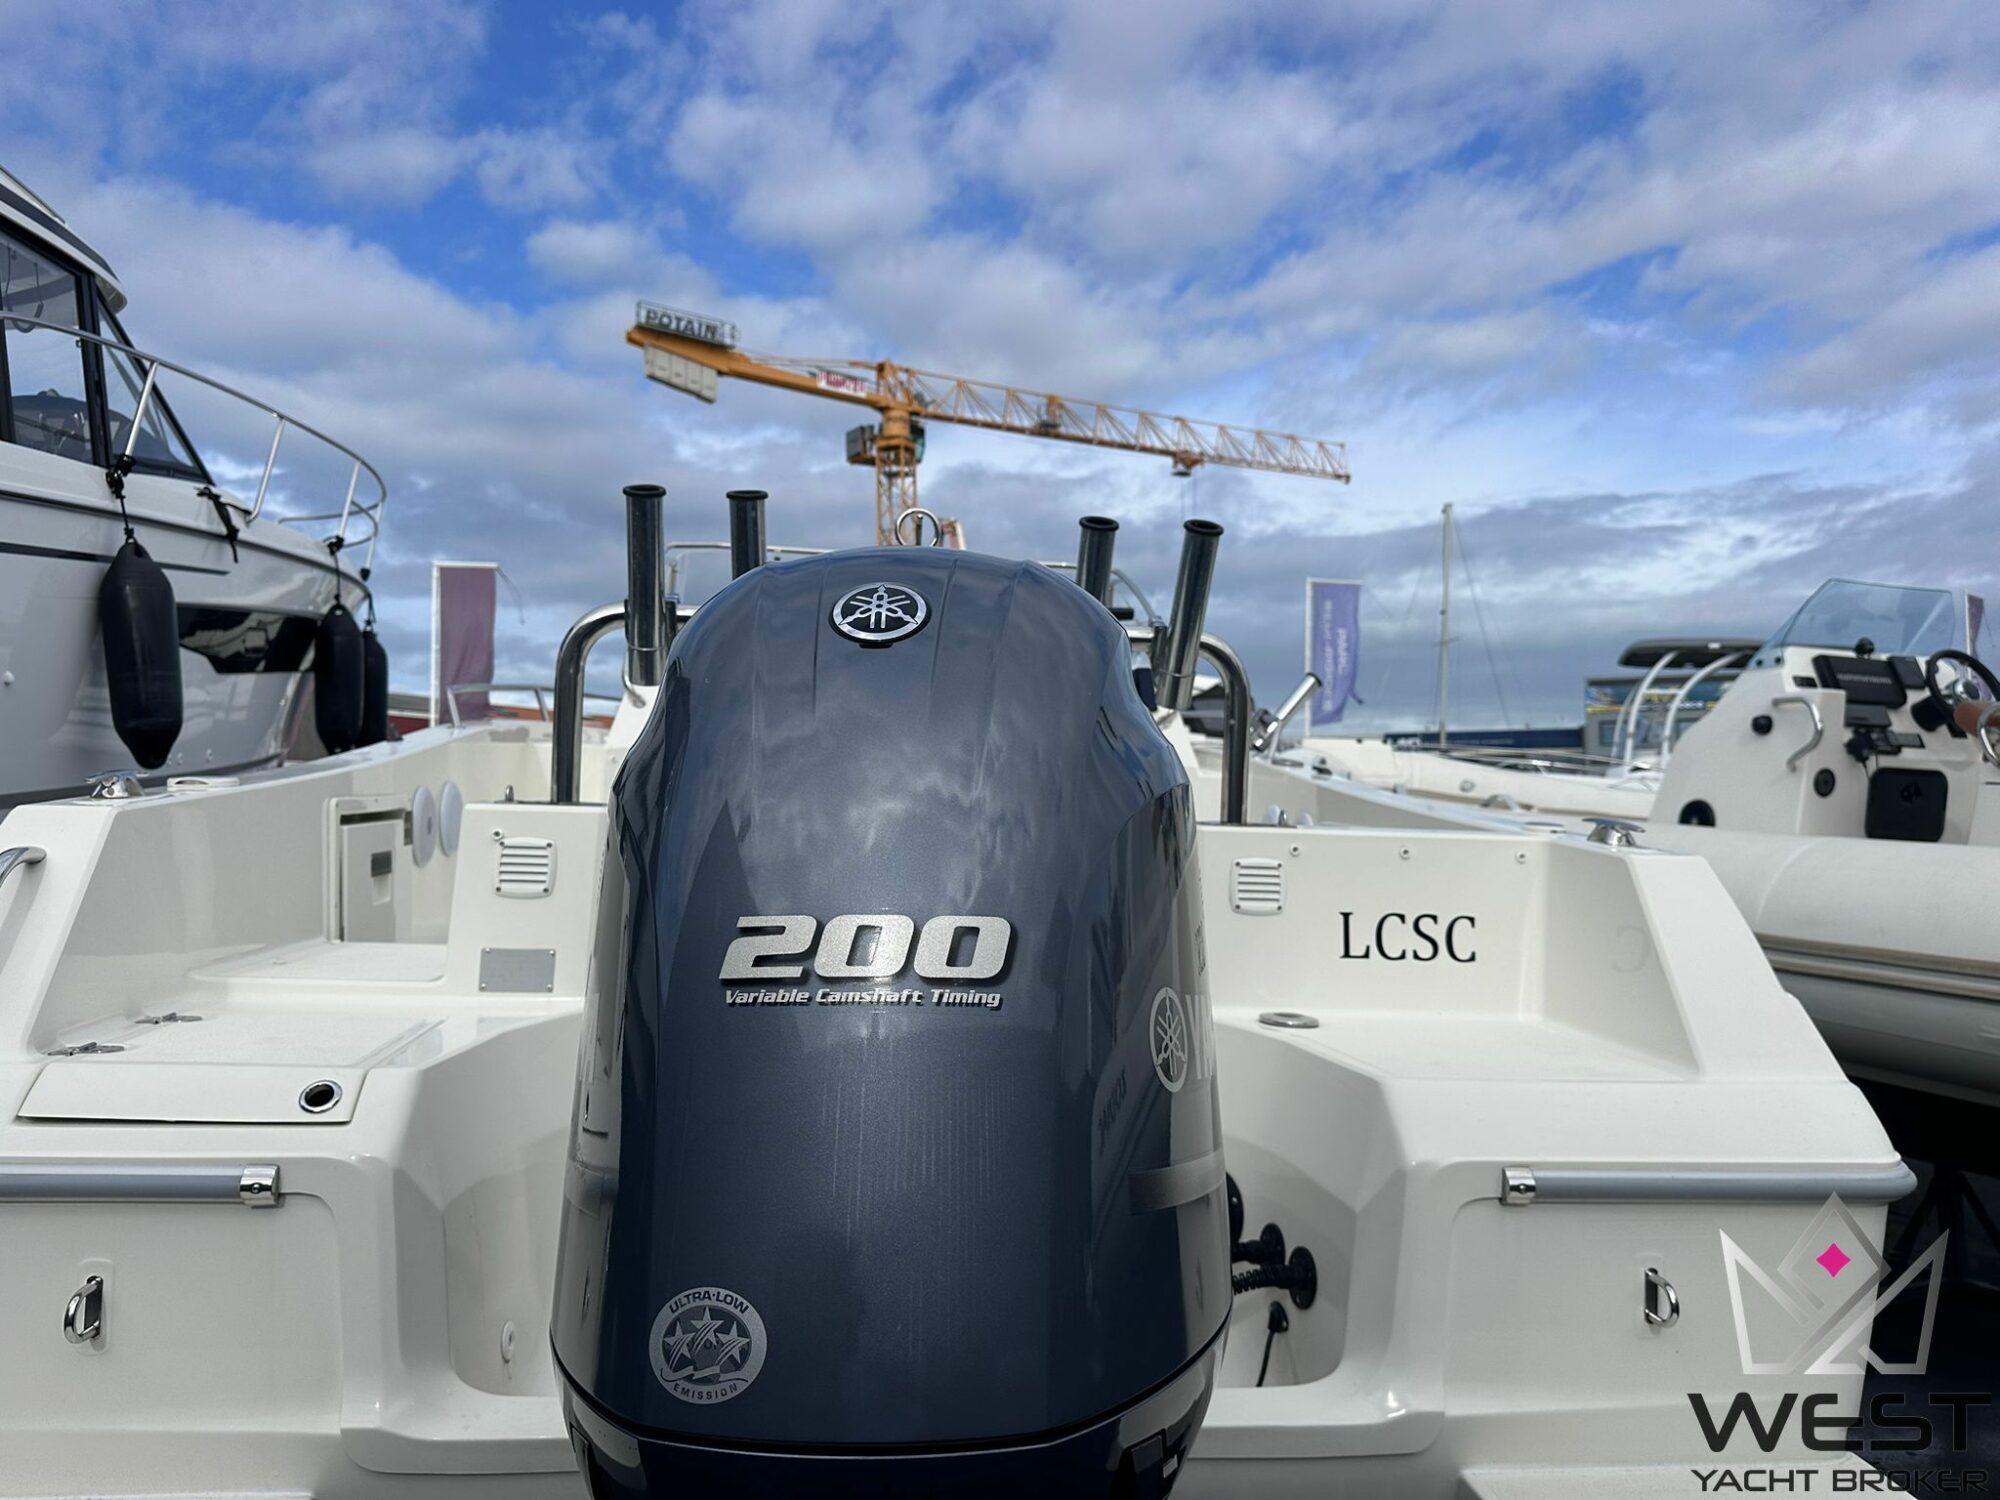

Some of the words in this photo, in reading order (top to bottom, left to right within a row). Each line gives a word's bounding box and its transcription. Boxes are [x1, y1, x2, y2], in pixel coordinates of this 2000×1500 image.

[645, 308, 717, 340] POTAIN
[718, 914, 1012, 979] 200
[1338, 911, 1477, 963] LCSC
[725, 988, 808, 1004] Variable
[815, 988, 922, 1004] Camshaft
[931, 988, 1001, 1007] Timing
[673, 1383, 738, 1400] EMISSION
